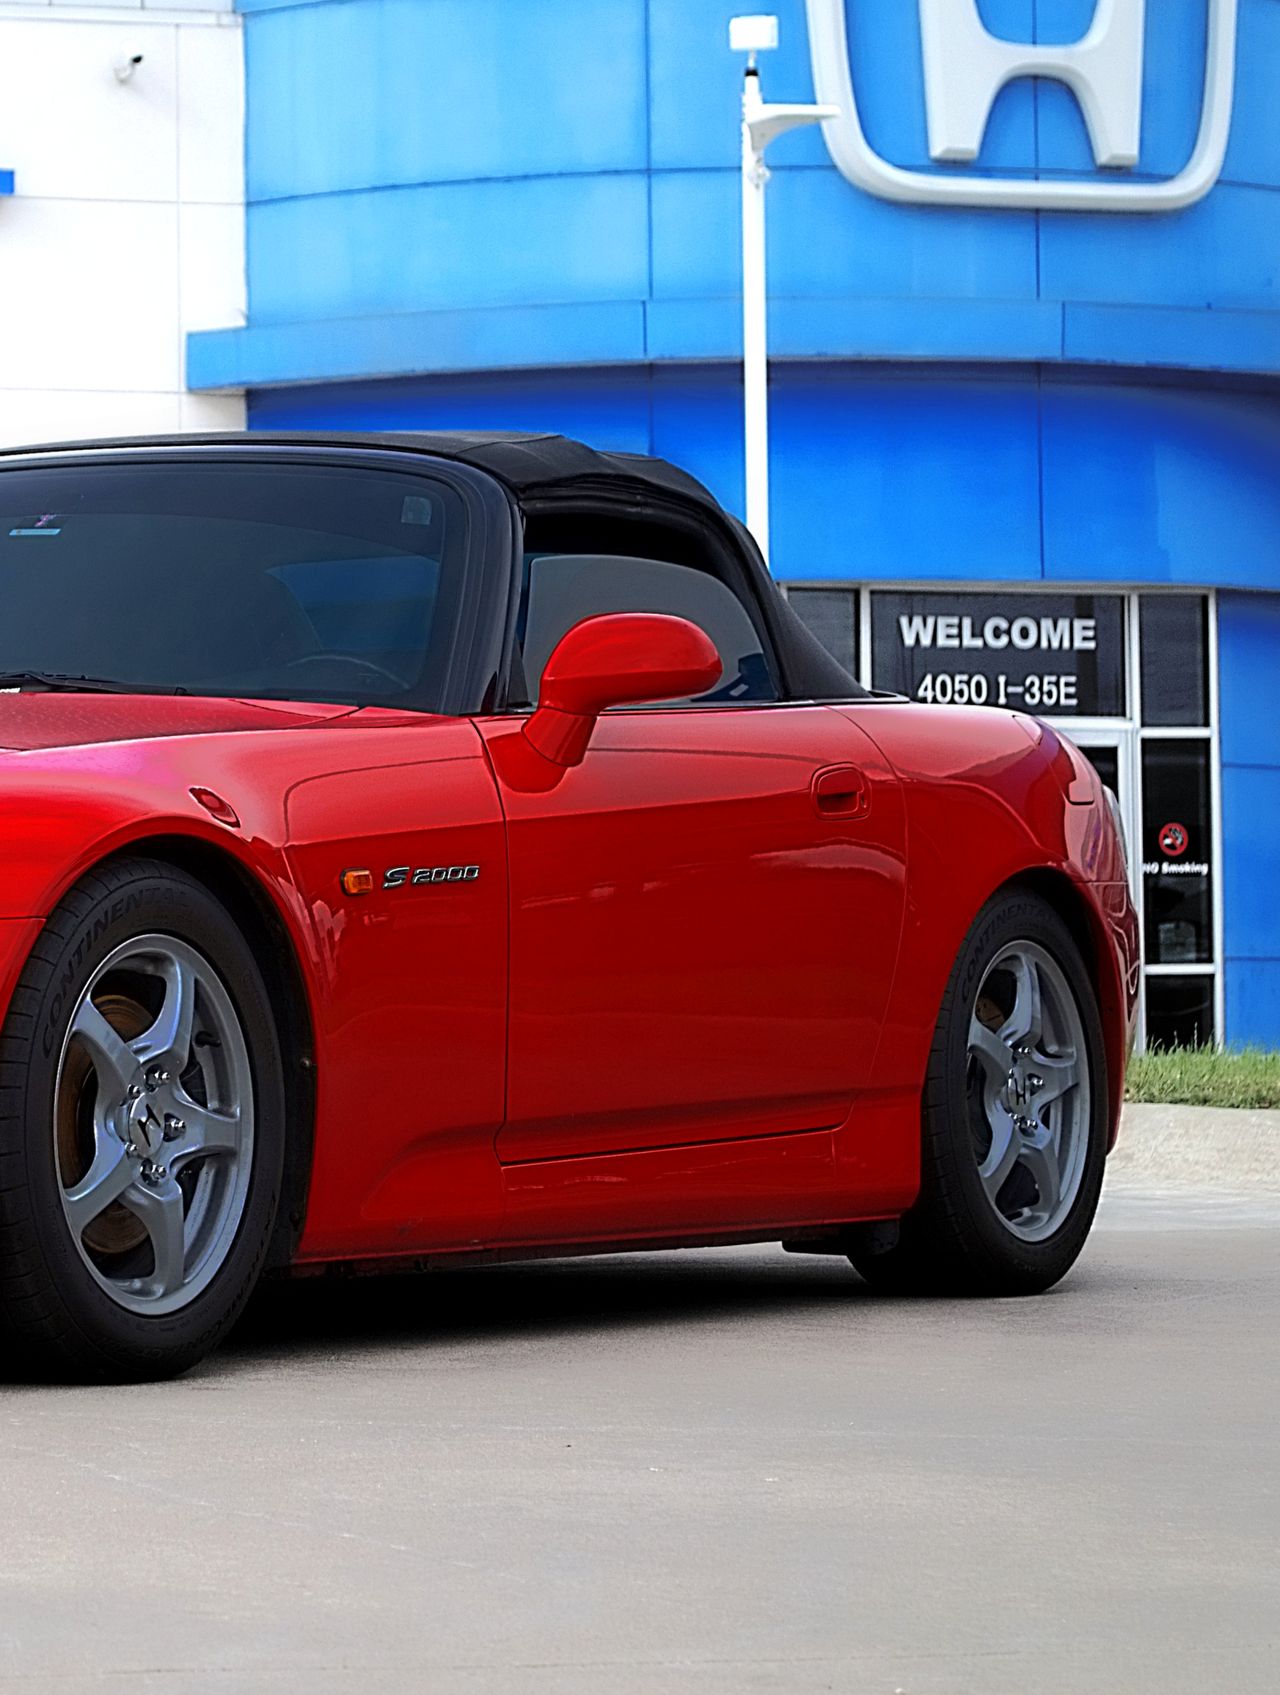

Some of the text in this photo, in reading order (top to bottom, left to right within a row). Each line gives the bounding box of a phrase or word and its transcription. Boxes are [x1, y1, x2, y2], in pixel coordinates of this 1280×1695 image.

[900, 615, 1096, 650] WELCOME
[917, 673, 1078, 706] 4050 I-35E
[413, 866, 480, 883] 2000
[1161, 861, 1209, 876] Smoking
